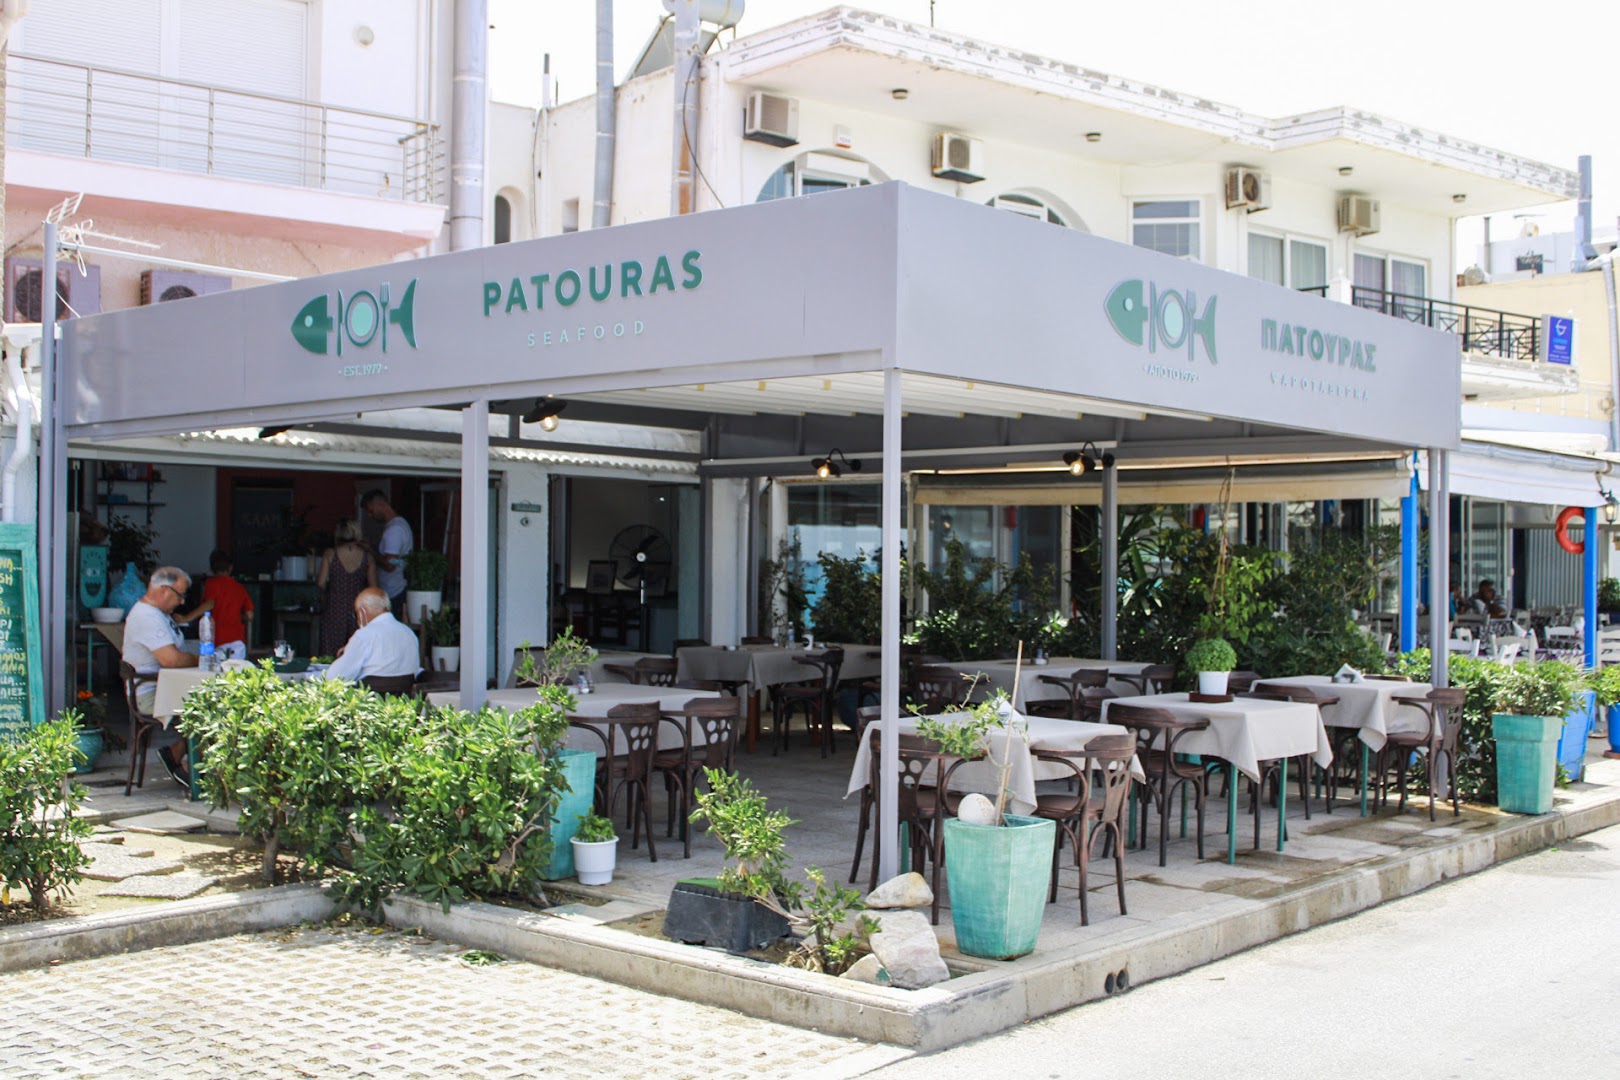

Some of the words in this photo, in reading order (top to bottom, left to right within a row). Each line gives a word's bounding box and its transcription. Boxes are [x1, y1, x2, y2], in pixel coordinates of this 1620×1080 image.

[484, 250, 704, 317] PATOURAS
[527, 321, 645, 347] SEAFOOD
[1261, 318, 1377, 373] ΠΑΤΟΥΡΑΣ
